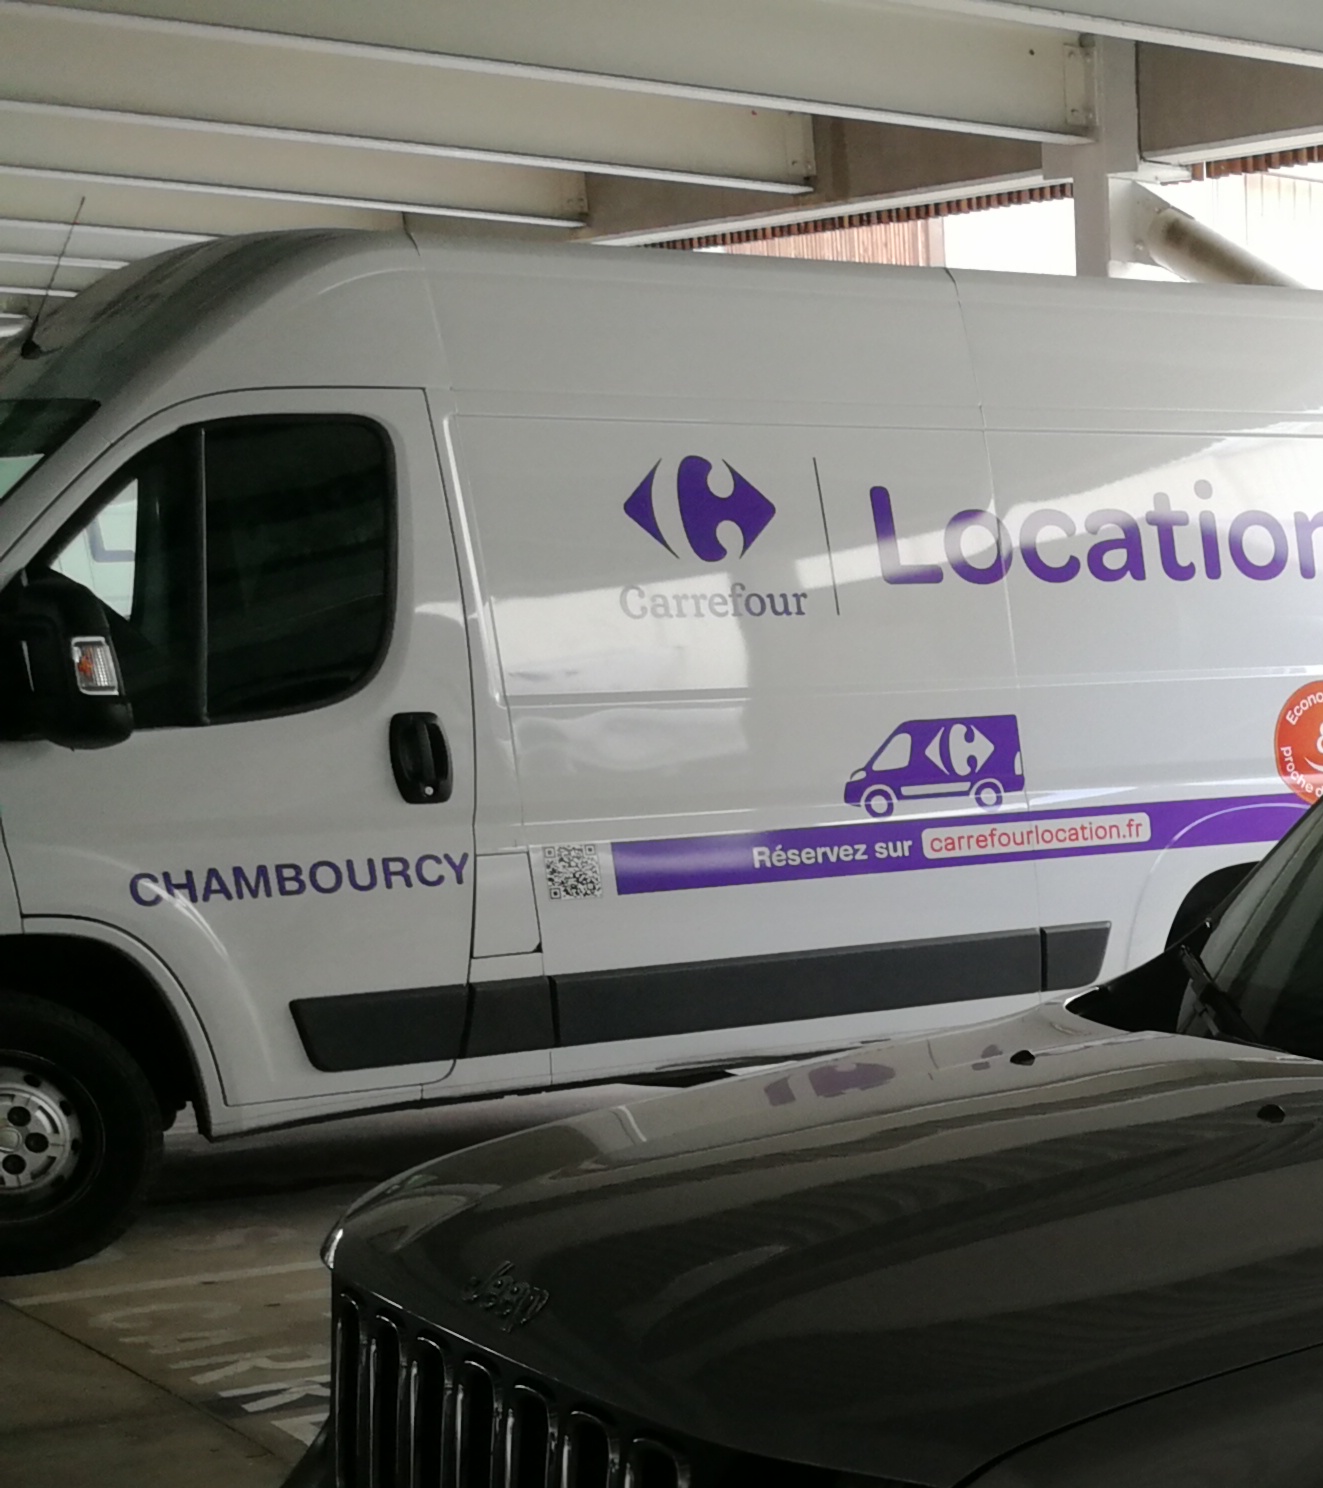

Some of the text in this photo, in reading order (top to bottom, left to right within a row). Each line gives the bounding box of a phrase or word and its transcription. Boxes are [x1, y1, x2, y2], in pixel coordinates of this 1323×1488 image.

[619, 582, 808, 620] Carrefour
[1280, 746, 1314, 793] proche
[752, 818, 1143, 869] Réservez sur carrefourlocation.fr
[129, 852, 470, 907] CHAMBOURCY
